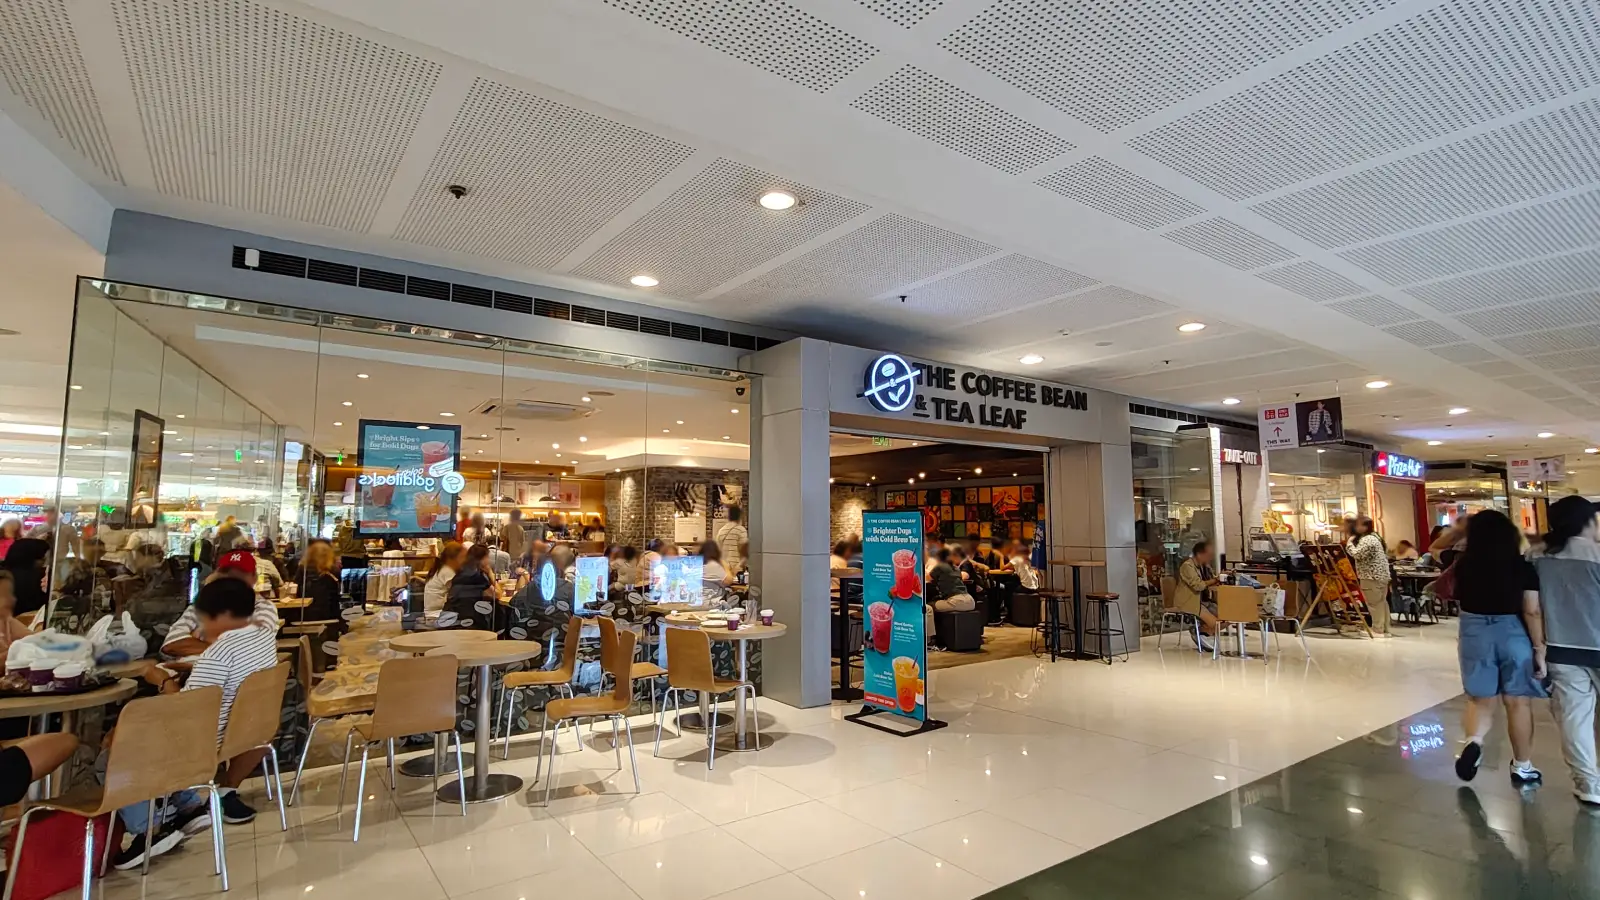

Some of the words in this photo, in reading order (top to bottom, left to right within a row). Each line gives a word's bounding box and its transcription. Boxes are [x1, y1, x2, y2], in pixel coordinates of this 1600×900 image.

[912, 362, 956, 391] THE
[961, 372, 1037, 404] COFFEE
[1041, 385, 1088, 411] BEAN
[914, 394, 928, 413] &
[931, 397, 974, 424] TEA
[979, 404, 1027, 430] LEAF
[375, 434, 398, 443] Bright
[399, 435, 415, 444] Sips
[1388, 454, 1408, 476] Pizza
[1408, 458, 1422, 477] Hut
[872, 527, 896, 535] Brighter
